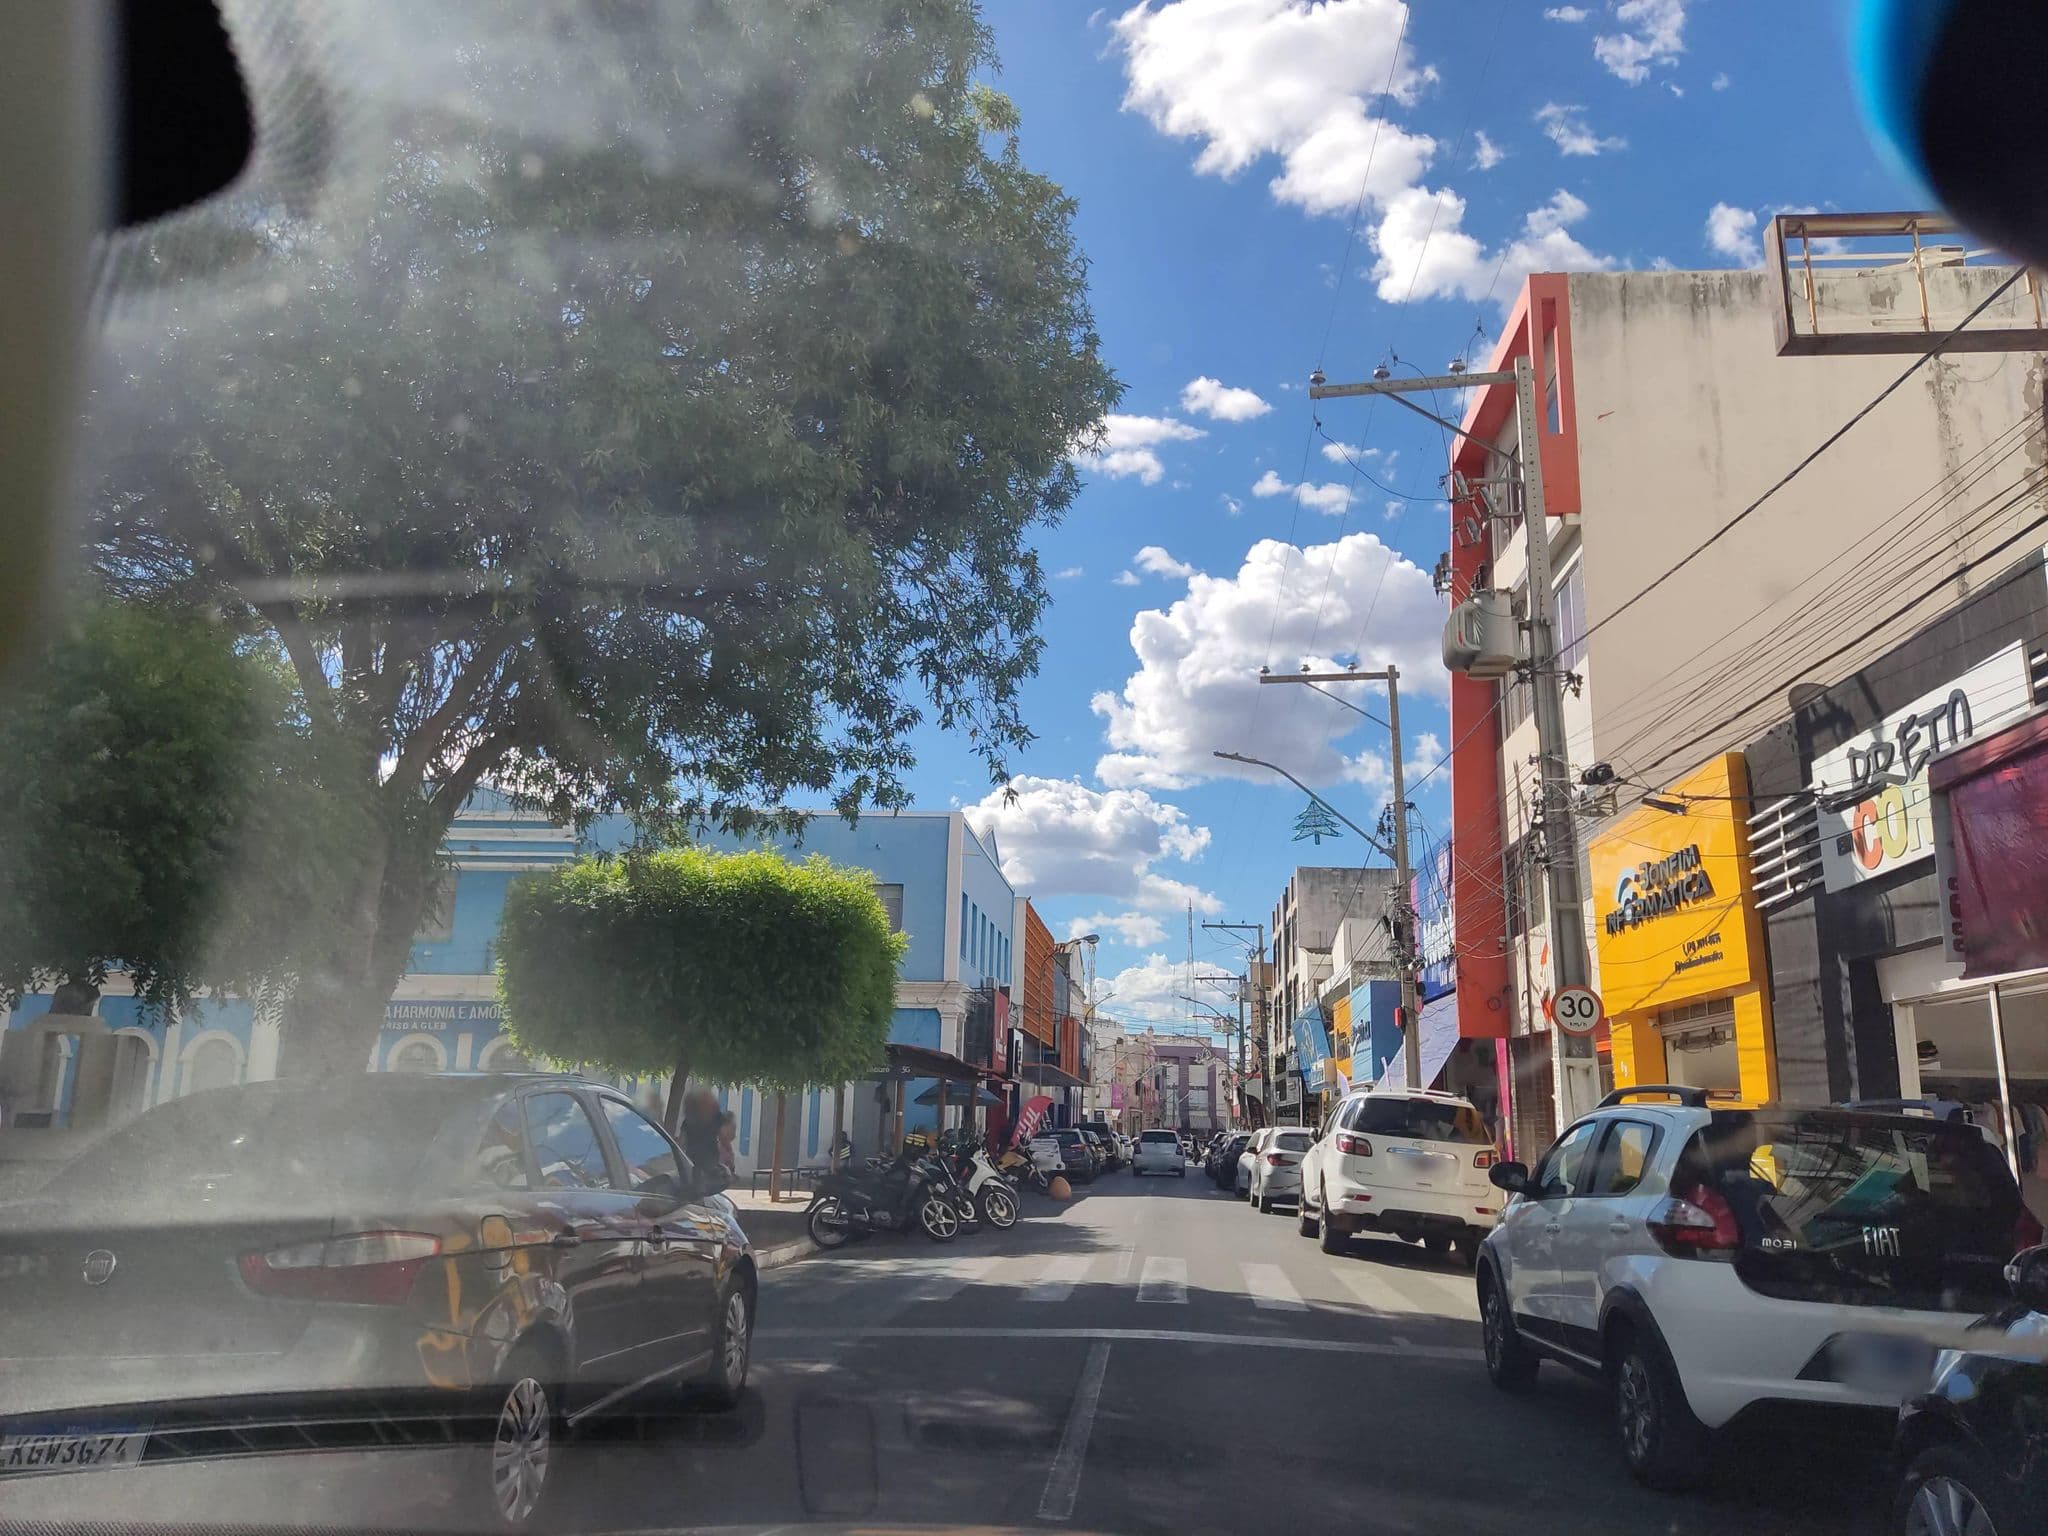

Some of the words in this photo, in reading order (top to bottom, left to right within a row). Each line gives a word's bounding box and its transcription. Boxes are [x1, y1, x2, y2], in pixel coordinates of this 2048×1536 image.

[1847, 688, 1973, 786] PRETO
[1635, 844, 1701, 890] BONFIM
[393, 1005, 456, 1019] HARMONIA
[459, 1006, 466, 1019] E
[1561, 996, 1594, 1018] 30
[1863, 1227, 1901, 1257] FIAT
